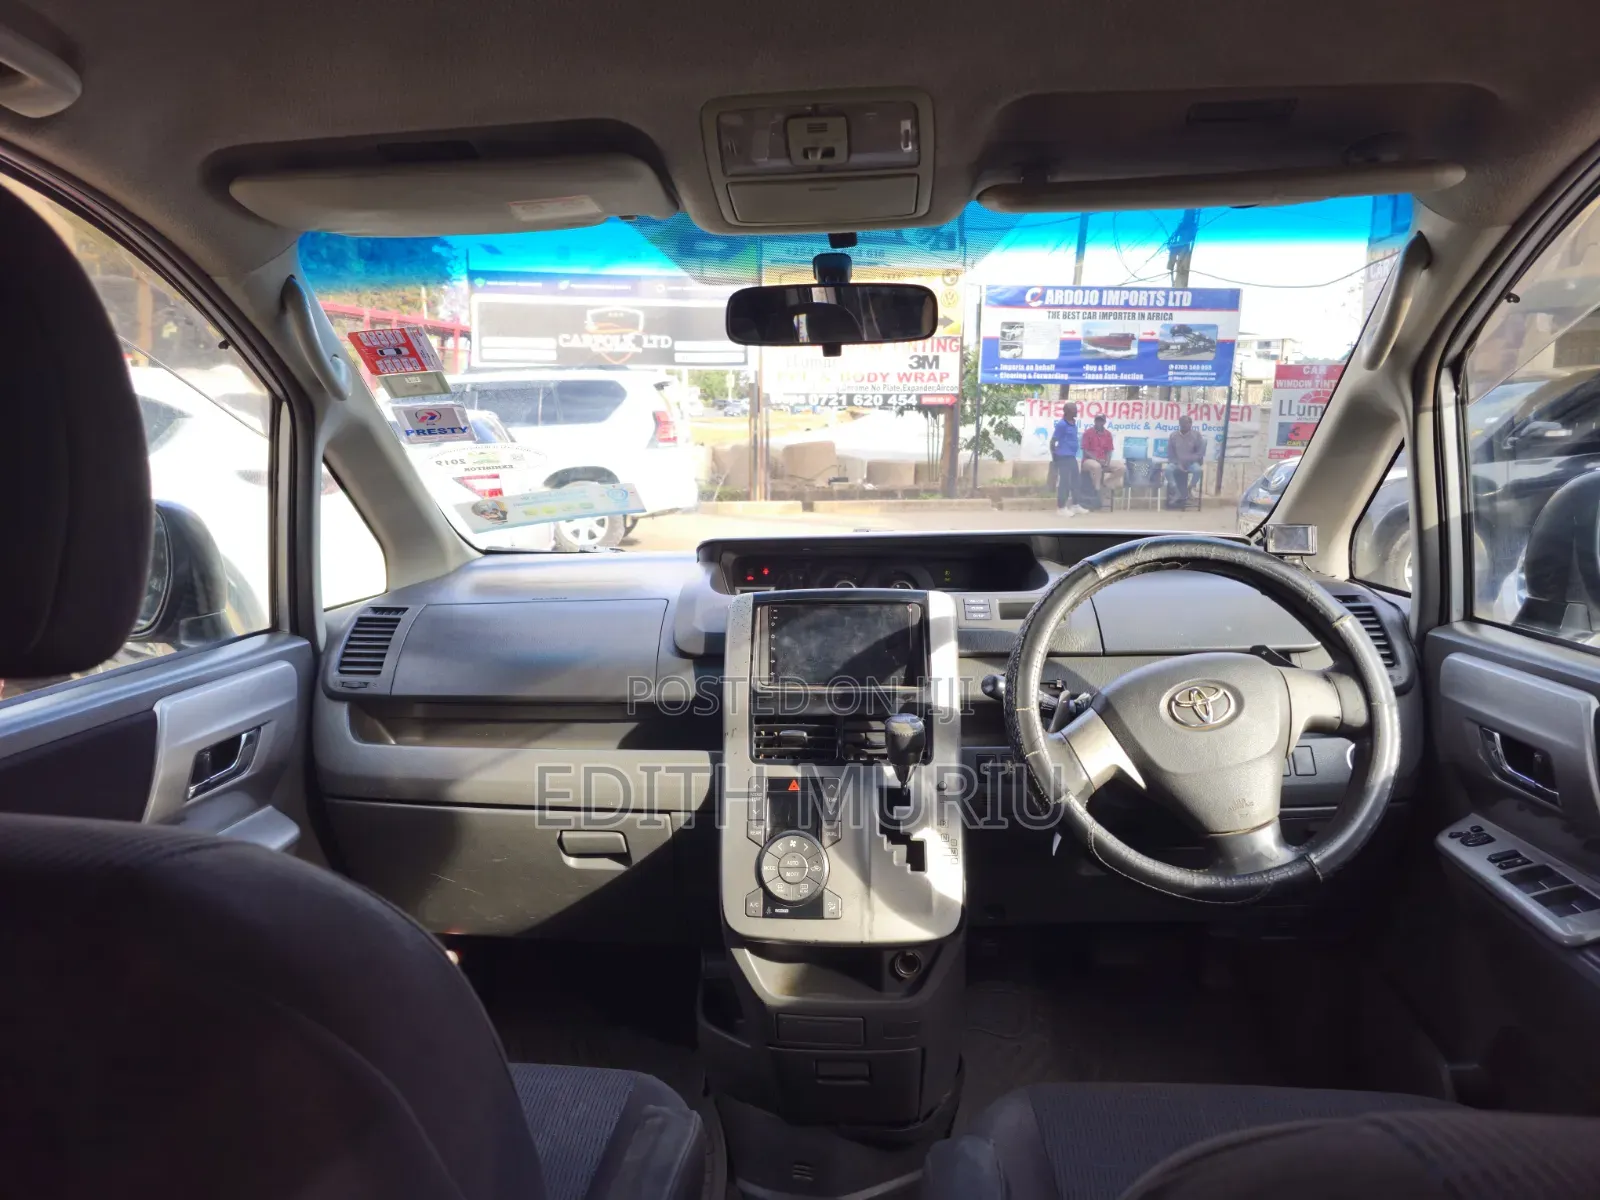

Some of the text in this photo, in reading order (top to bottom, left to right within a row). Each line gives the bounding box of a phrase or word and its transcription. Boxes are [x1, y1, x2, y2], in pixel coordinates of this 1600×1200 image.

[1102, 289, 1165, 306] IMPORTS
[1168, 290, 1192, 307] LTD
[1047, 311, 1174, 321] THE BEST CAR IMPORTER IN AFRICA
[908, 354, 940, 370] 3M
[1302, 366, 1327, 375] CAR
[896, 372, 950, 383] WRAP
[1275, 380, 1312, 389] WINDOW
[808, 394, 847, 406] 0721
[852, 394, 884, 406] 620
[887, 394, 918, 406] 454
[1026, 400, 1252, 422] THE AQUARIUM HAVEN
[405, 426, 468, 436] PRESTY
[1107, 420, 1141, 431] Aquatic
